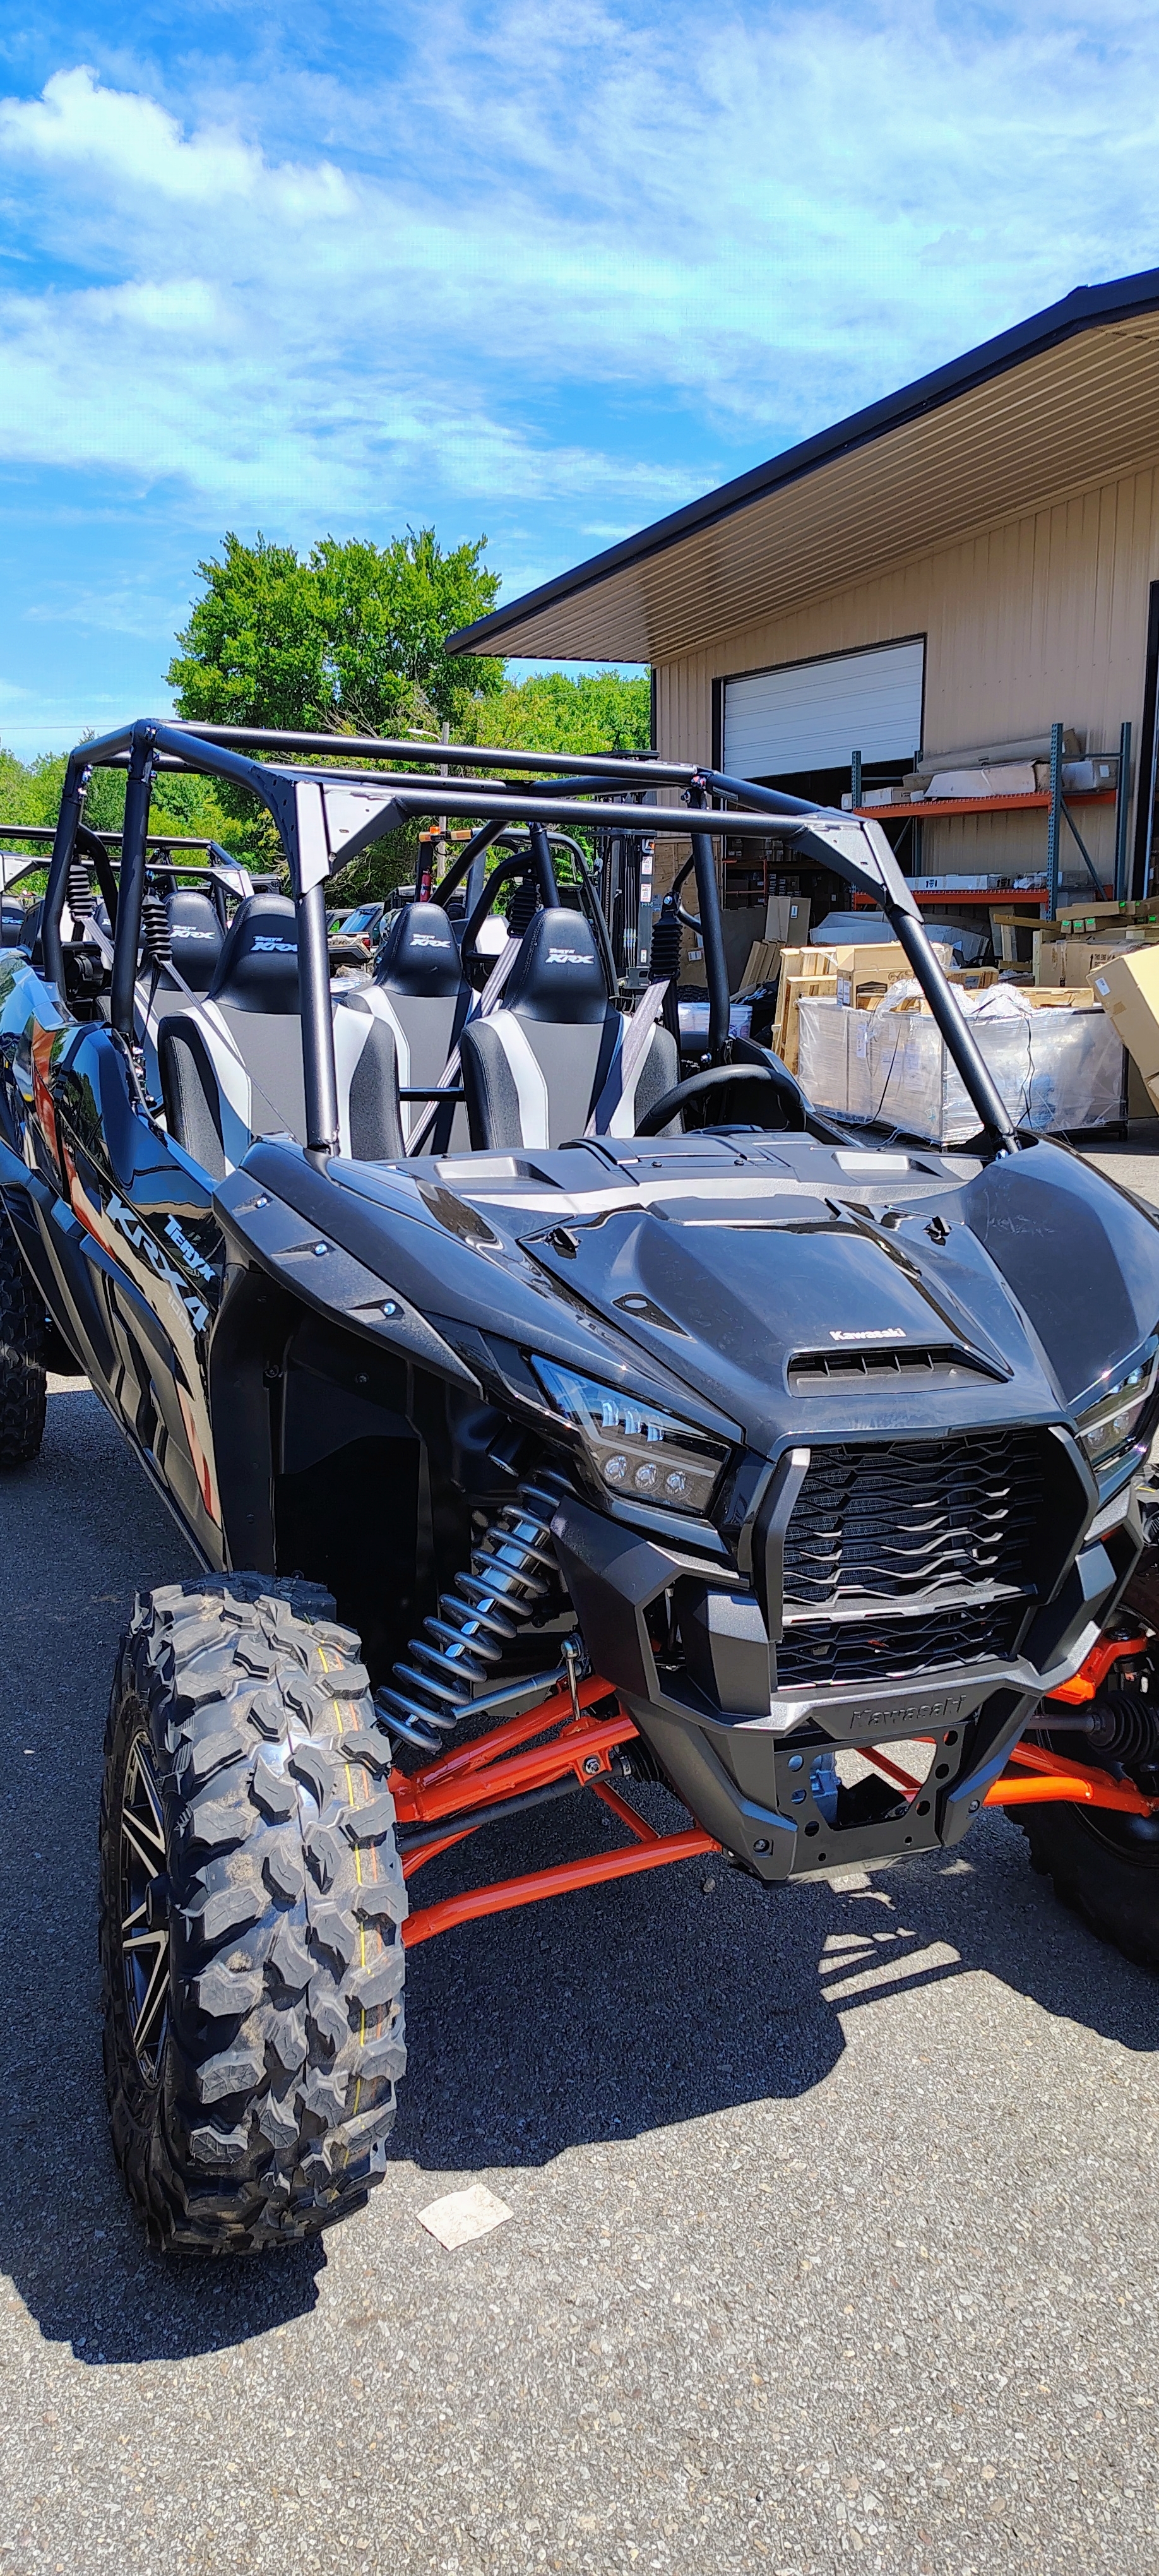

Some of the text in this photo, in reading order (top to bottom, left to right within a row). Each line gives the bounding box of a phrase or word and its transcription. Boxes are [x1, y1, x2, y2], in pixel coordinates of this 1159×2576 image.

[170, 930, 215, 939] KRX
[410, 938, 451, 948] KRX
[545, 954, 595, 964] KRX
[167, 1292, 197, 1341] 1000
[829, 1328, 907, 1340] Kawasaki
[850, 1693, 967, 1729] Kawasaki
